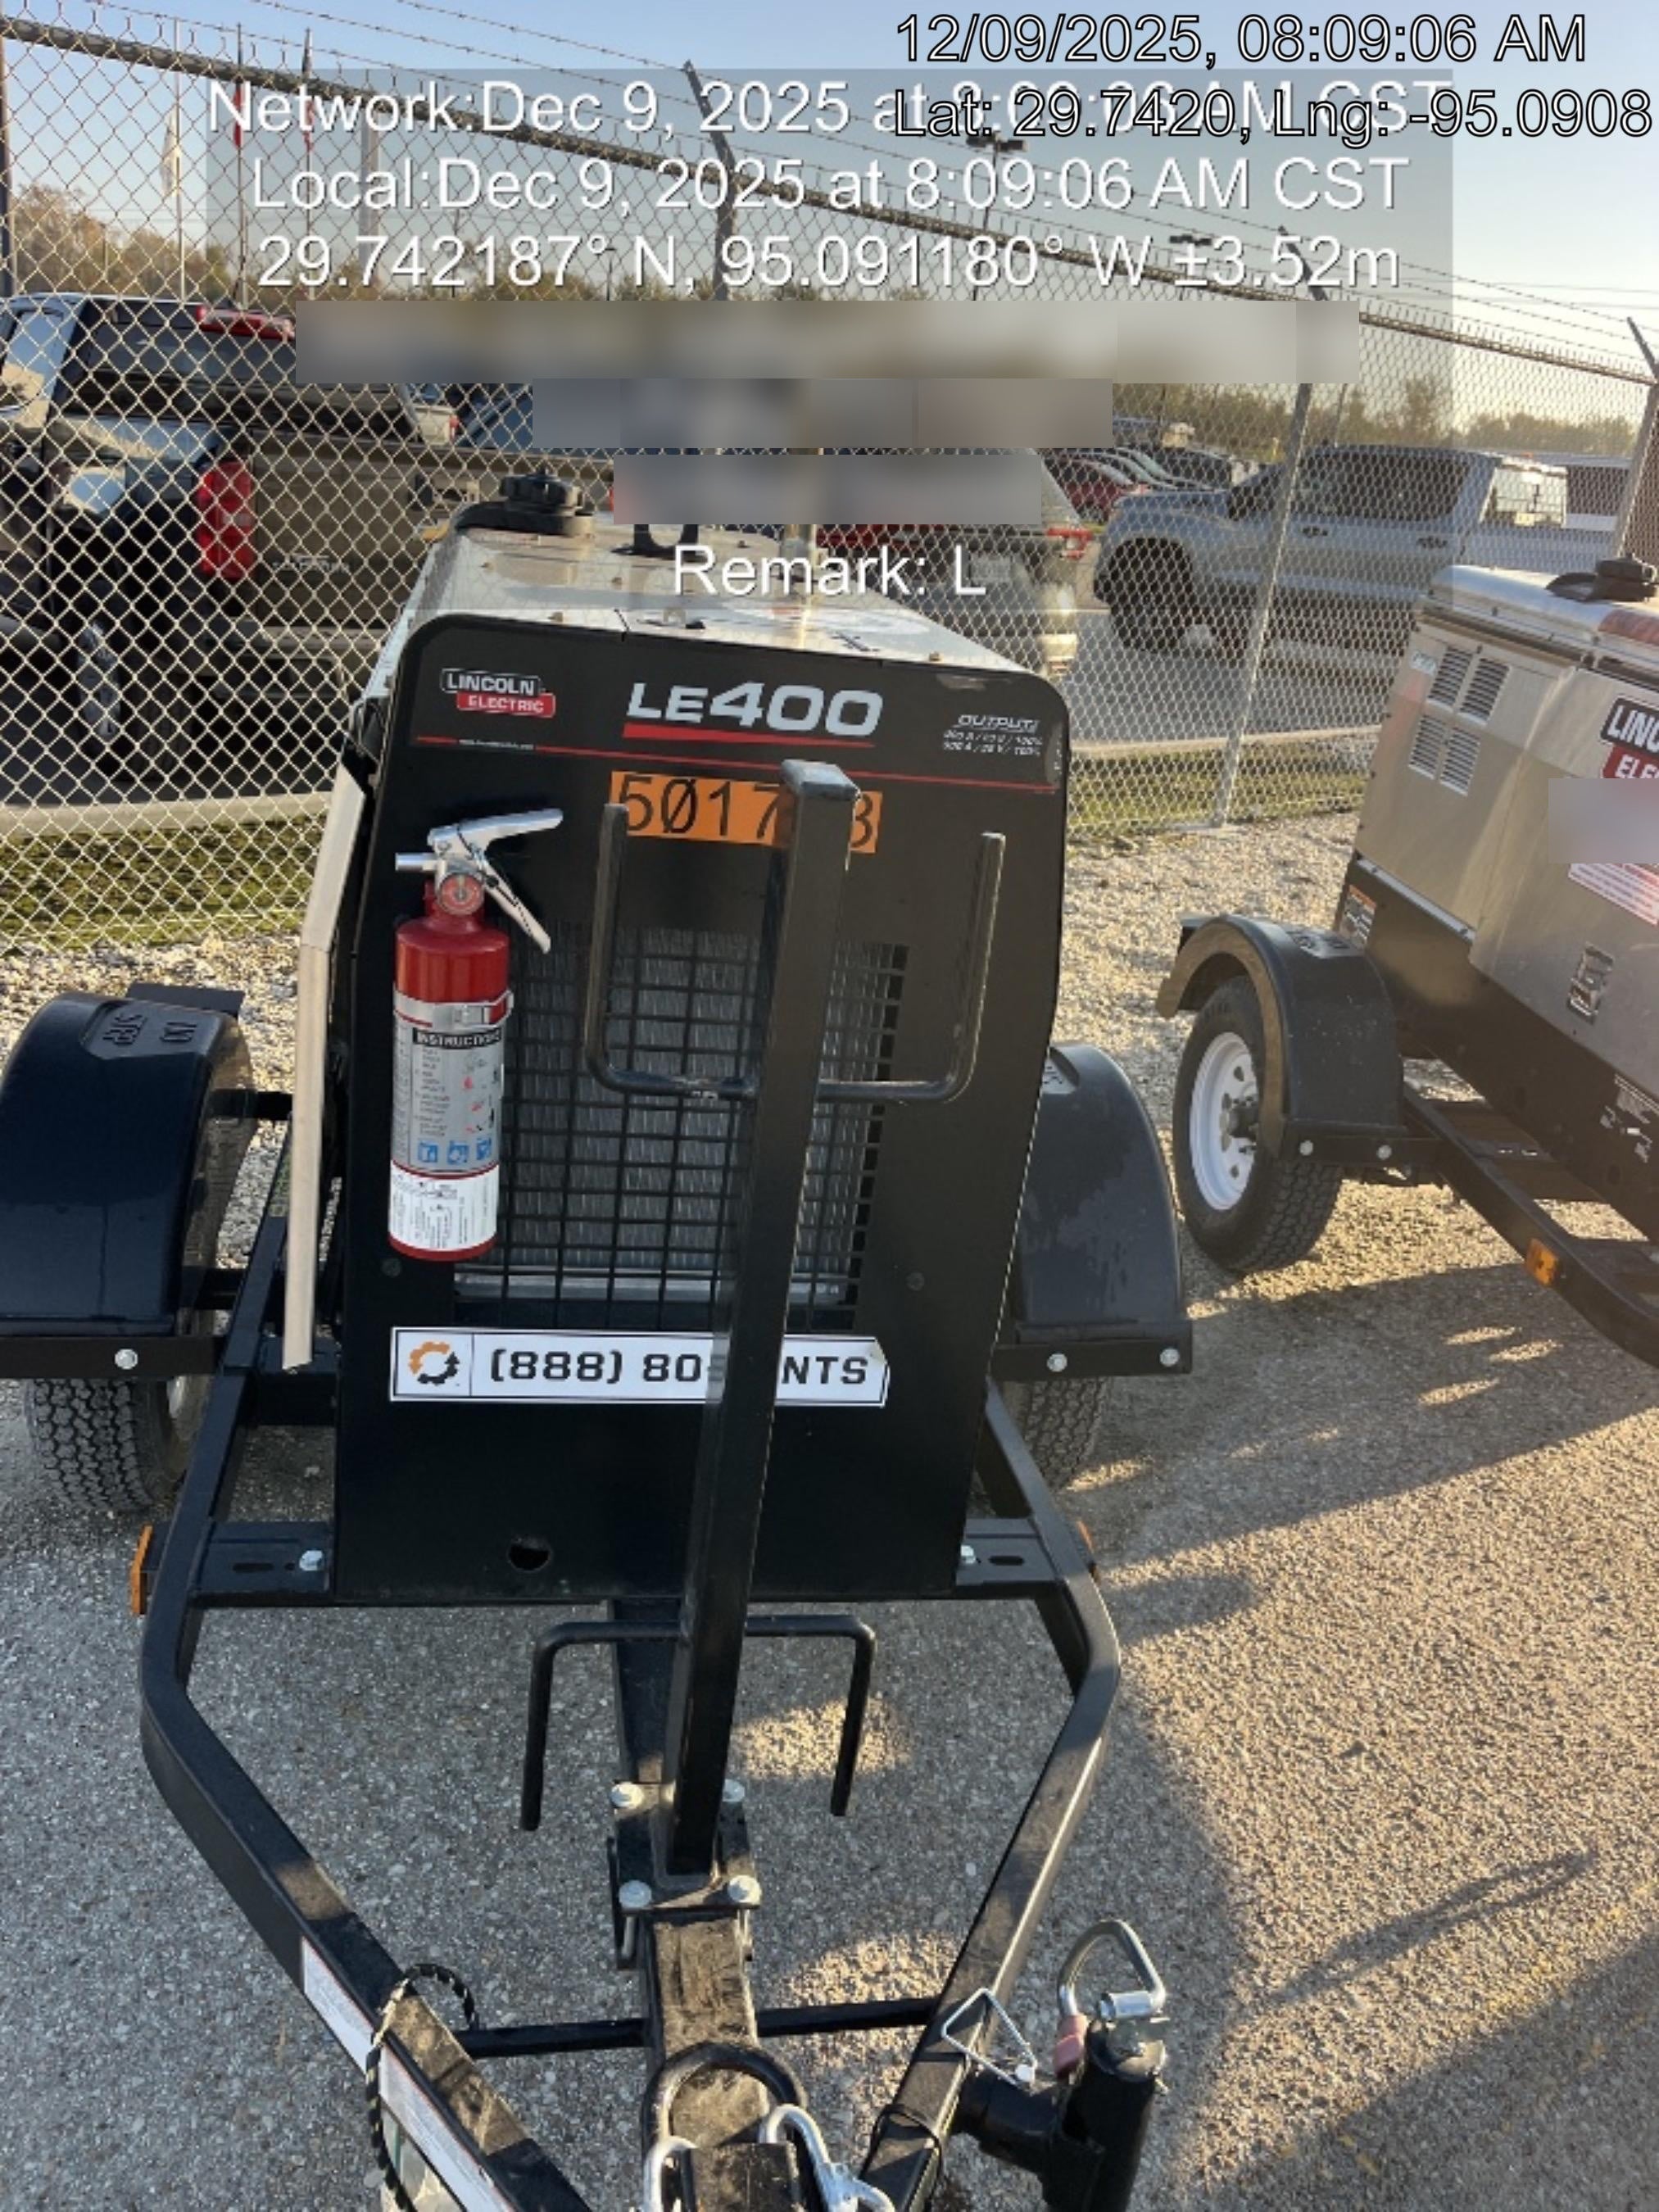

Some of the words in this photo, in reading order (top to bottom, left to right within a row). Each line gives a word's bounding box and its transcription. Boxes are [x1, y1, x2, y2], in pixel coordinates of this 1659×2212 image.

[446, 672, 536, 697] LINCOLN
[468, 694, 546, 714] ELECTRIC
[625, 681, 885, 737] LE400
[491, 1348, 623, 1385] (888)
